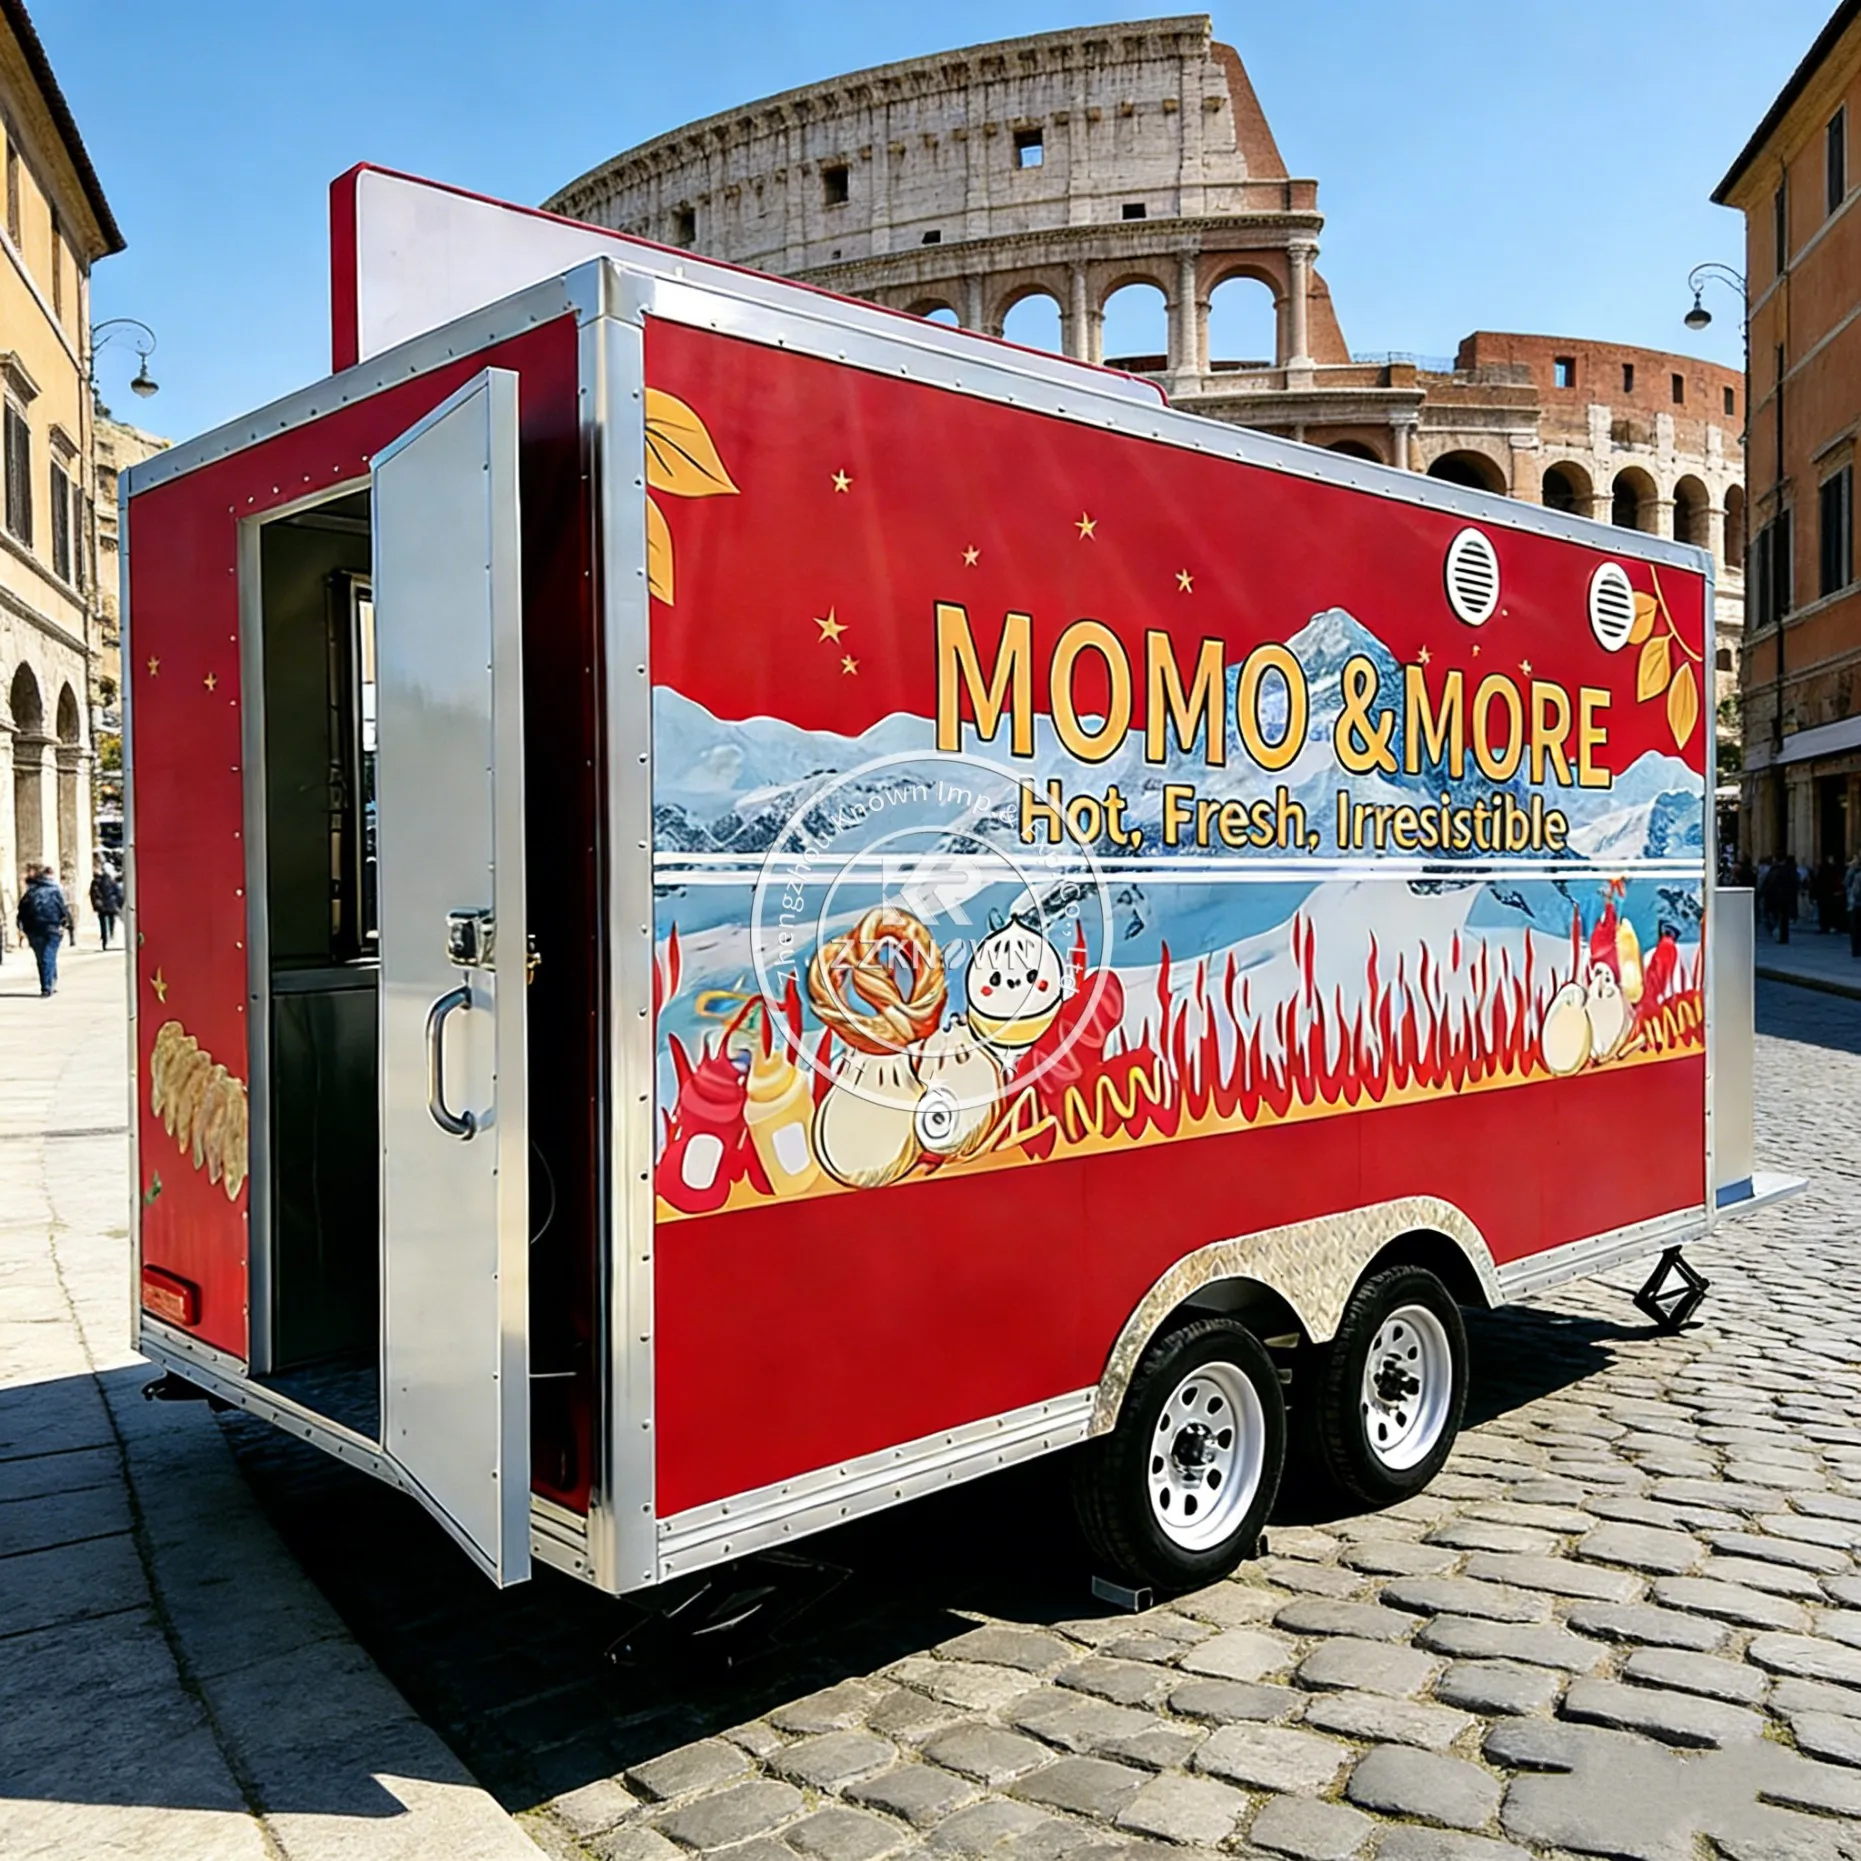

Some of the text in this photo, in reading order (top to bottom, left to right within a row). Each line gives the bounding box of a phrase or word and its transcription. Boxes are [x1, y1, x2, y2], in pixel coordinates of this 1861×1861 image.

[934, 602, 1309, 772] MOMO
[1019, 778, 1569, 854] Hot, Fresh, Irresistible
